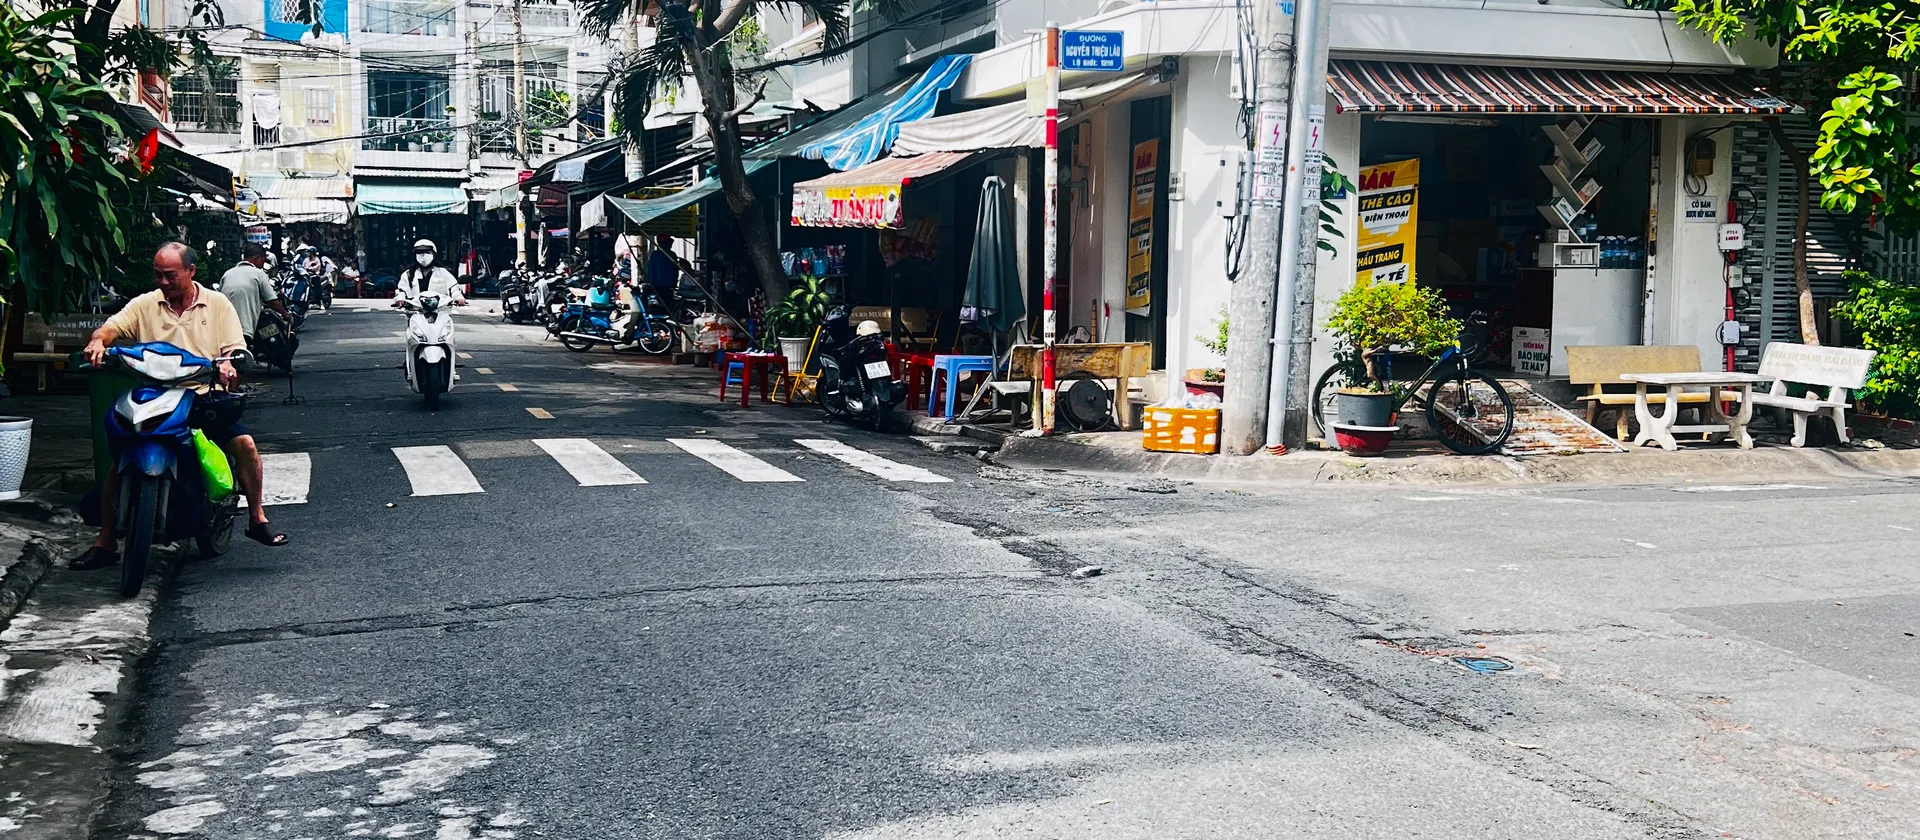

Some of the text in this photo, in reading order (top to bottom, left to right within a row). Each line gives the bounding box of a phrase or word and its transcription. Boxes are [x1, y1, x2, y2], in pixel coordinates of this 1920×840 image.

[1079, 34, 1107, 42] ĐƯỜNG
[1066, 42, 1090, 57] NGUYỄN
[1359, 168, 1395, 192] BÁN
[1361, 193, 1384, 210] THẺ
[1691, 200, 1700, 208] CÓ
[1364, 209, 1410, 224] ĐIỆN THOẠI
[1357, 249, 1400, 268] HẨU TRANG
[1388, 265, 1406, 282] TẾ
[1521, 361, 1529, 370] XE
